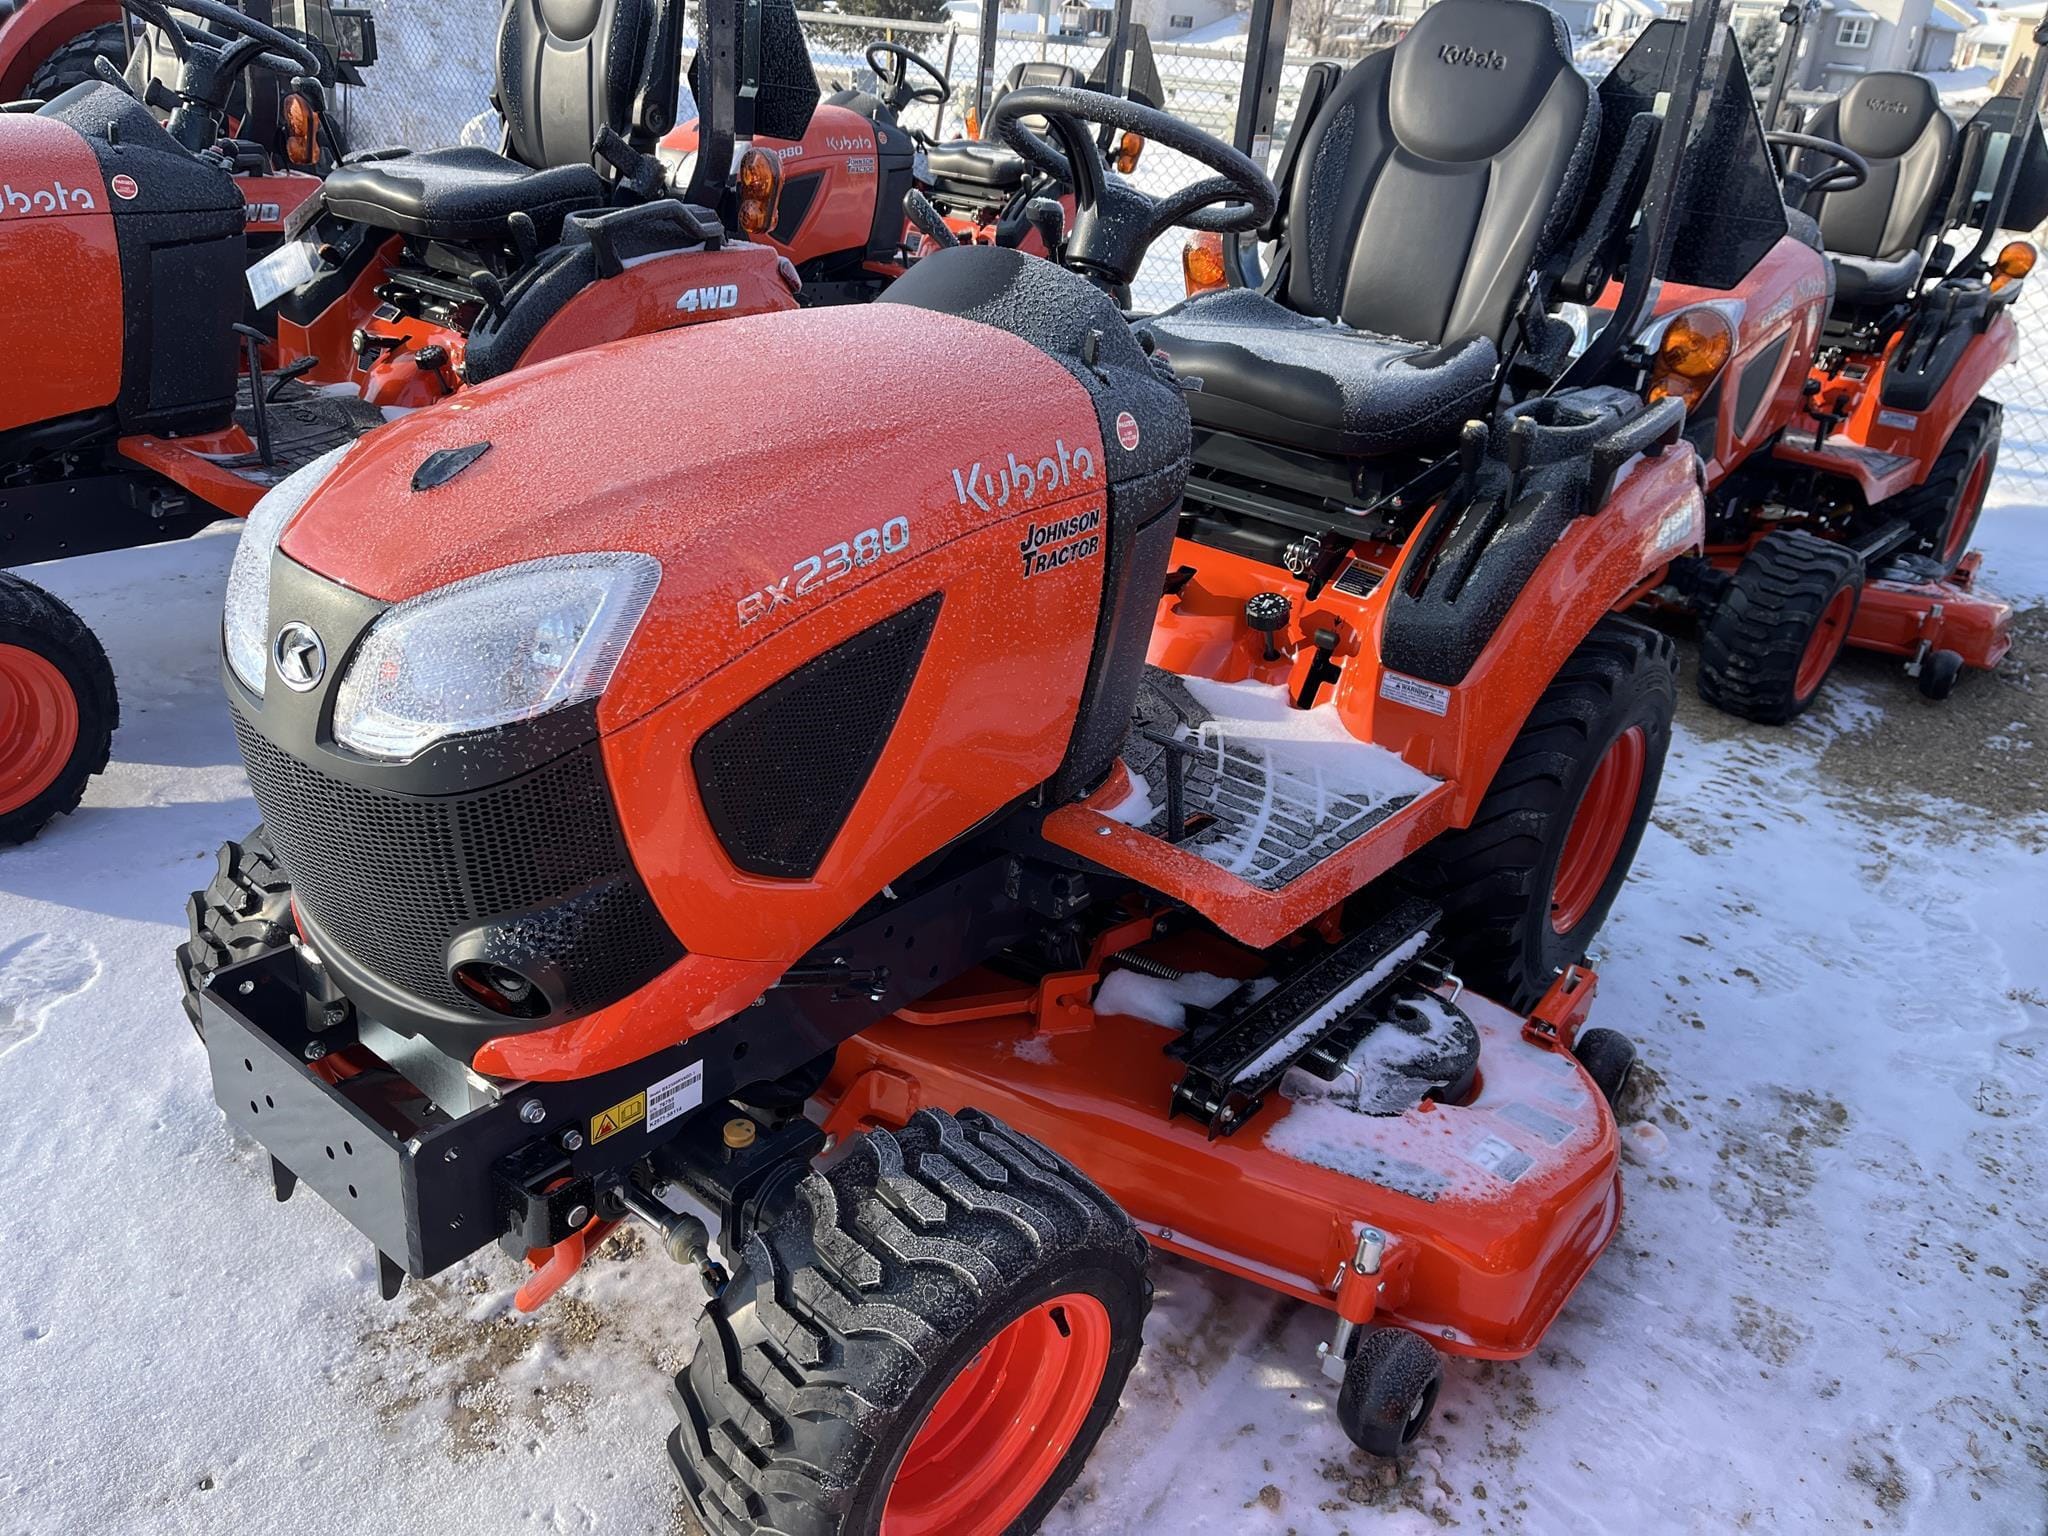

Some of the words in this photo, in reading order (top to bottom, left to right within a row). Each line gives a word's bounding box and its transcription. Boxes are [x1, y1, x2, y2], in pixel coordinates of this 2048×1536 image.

[1438, 44, 1507, 71] Kubota
[826, 135, 872, 151] Kubota
[0, 181, 95, 213] bota
[243, 203, 280, 222] WD
[676, 284, 738, 312] 4WD
[952, 439, 1095, 512] Kubota
[1020, 509, 1101, 552] JOHNSON
[737, 515, 910, 629] BX2380
[1022, 535, 1100, 579] TRACTOR
[1401, 684, 1429, 697] WARNING
